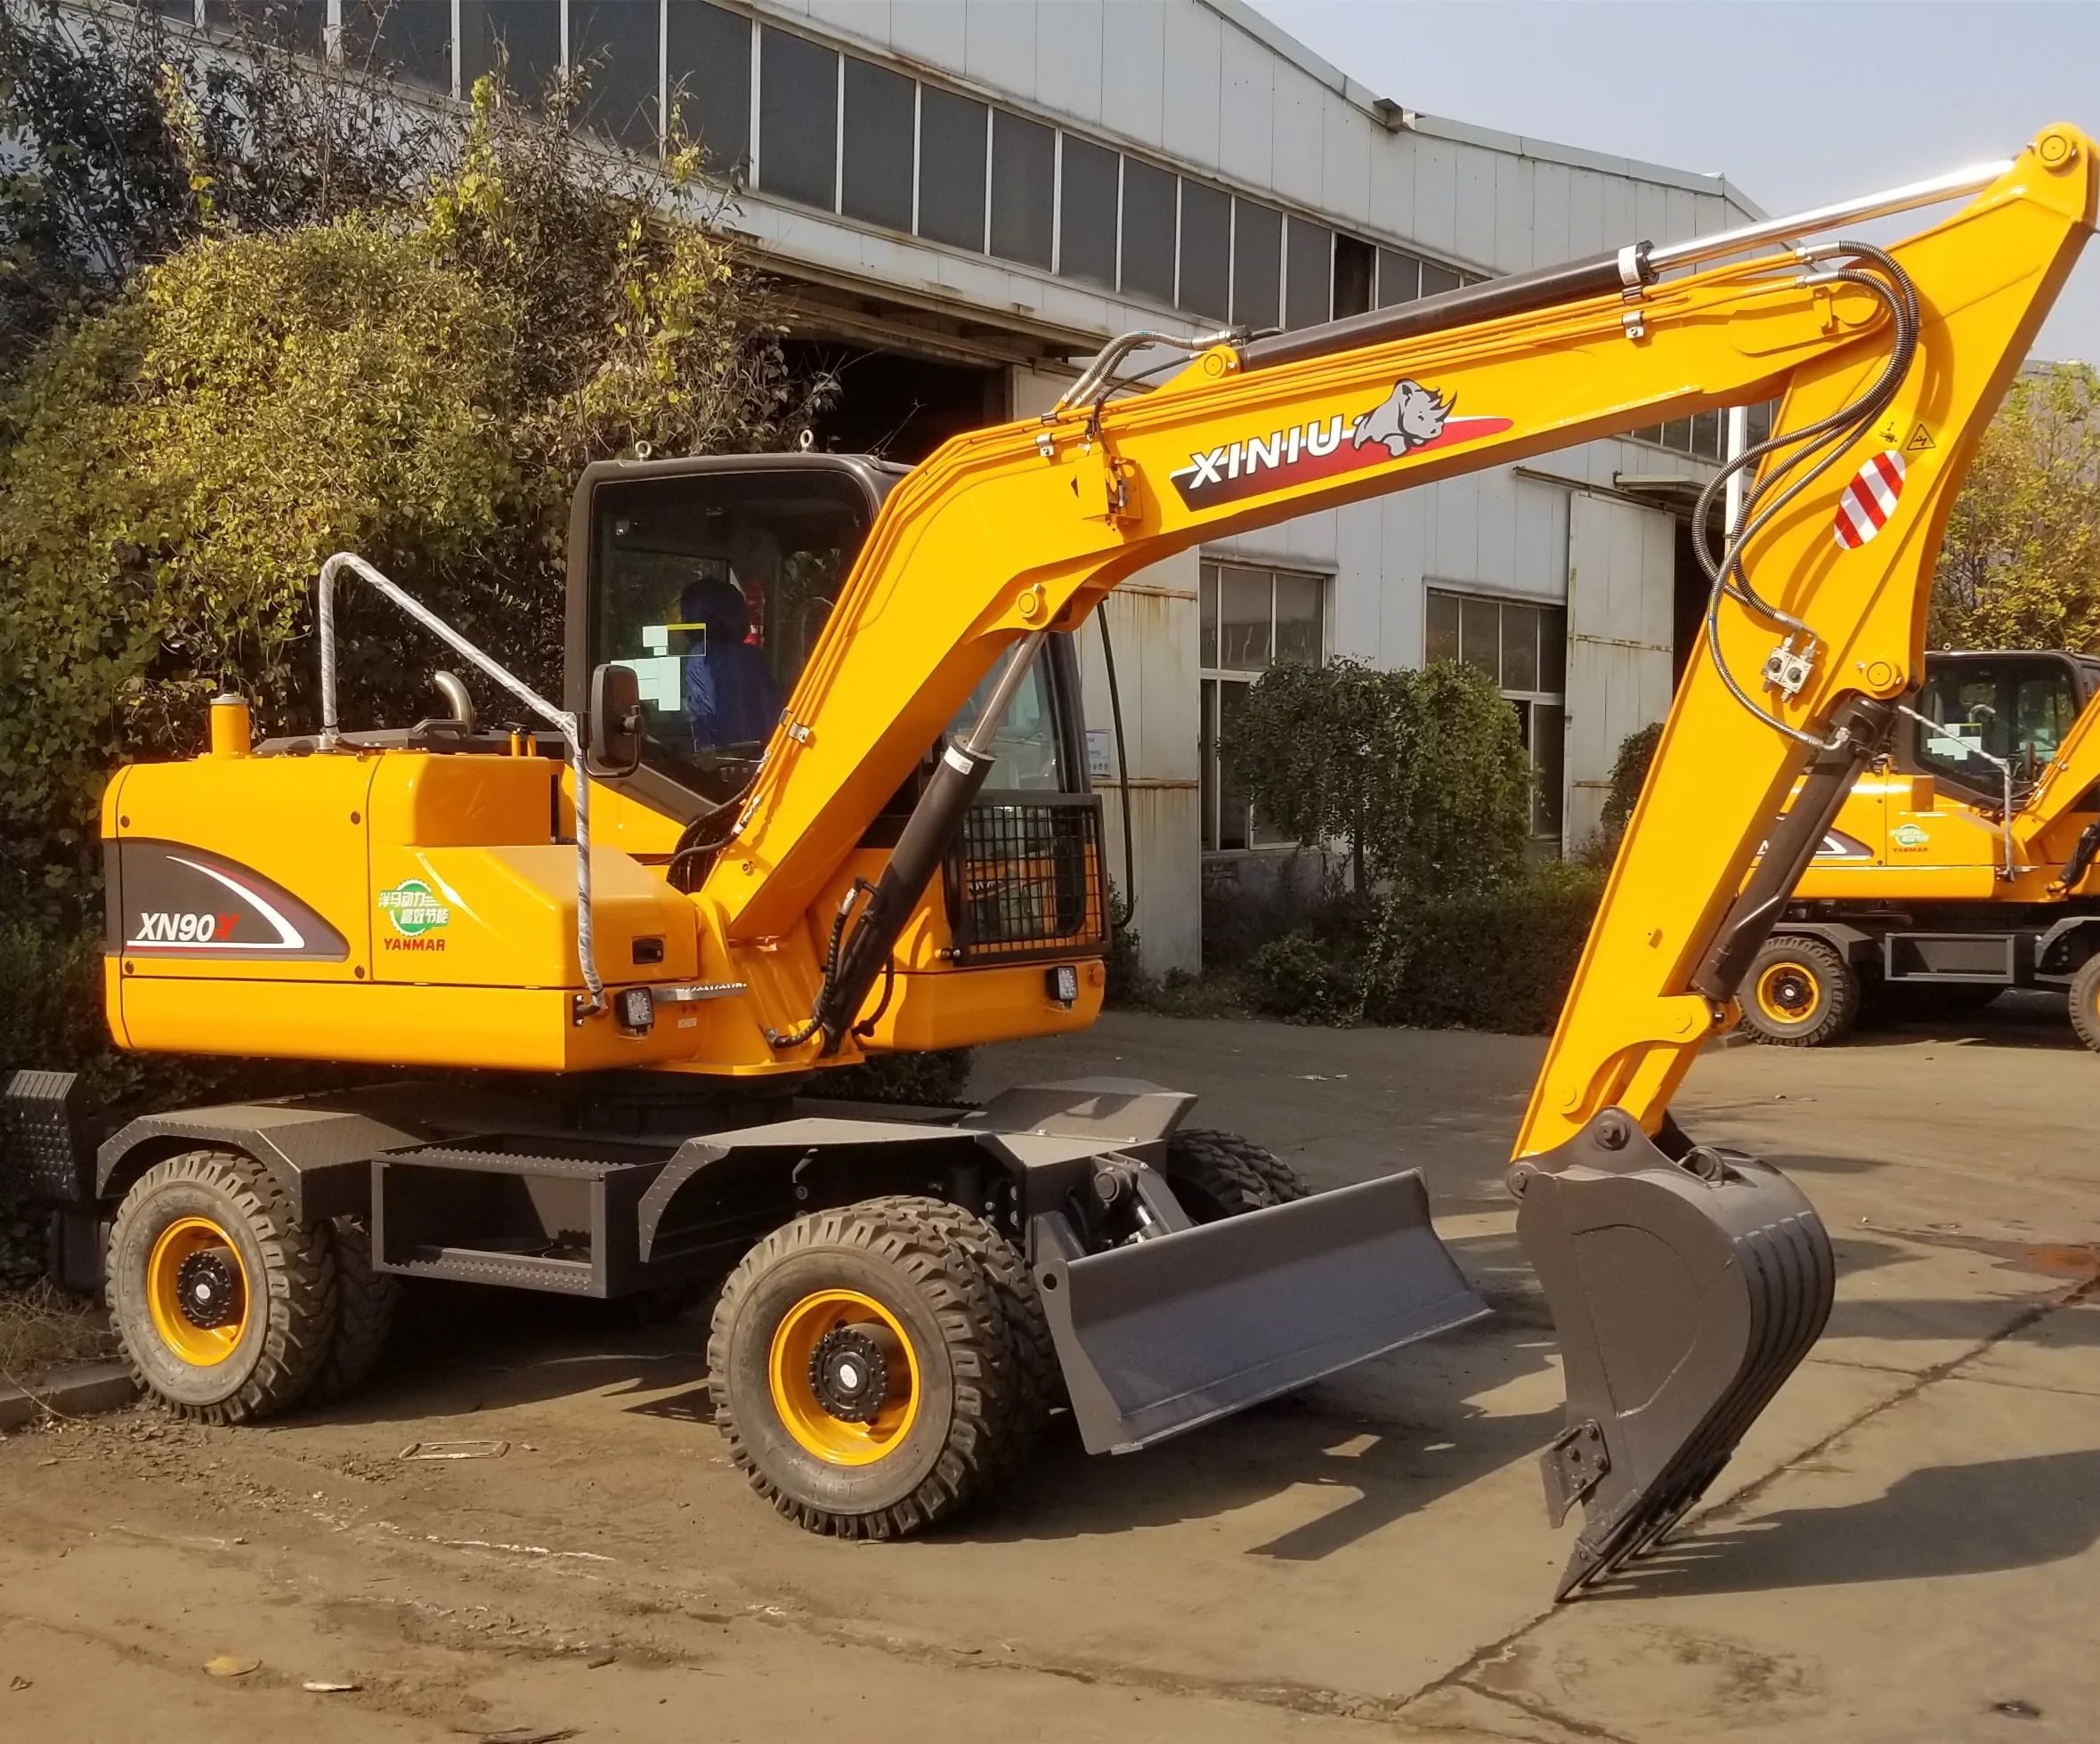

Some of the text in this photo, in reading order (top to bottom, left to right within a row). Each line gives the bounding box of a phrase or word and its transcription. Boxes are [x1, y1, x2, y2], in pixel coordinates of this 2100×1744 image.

[1188, 413, 1344, 490] XINIU
[378, 891, 426, 908] 洋马动力
[400, 908, 449, 924] 高效节能
[384, 937, 445, 952] YANMAR
